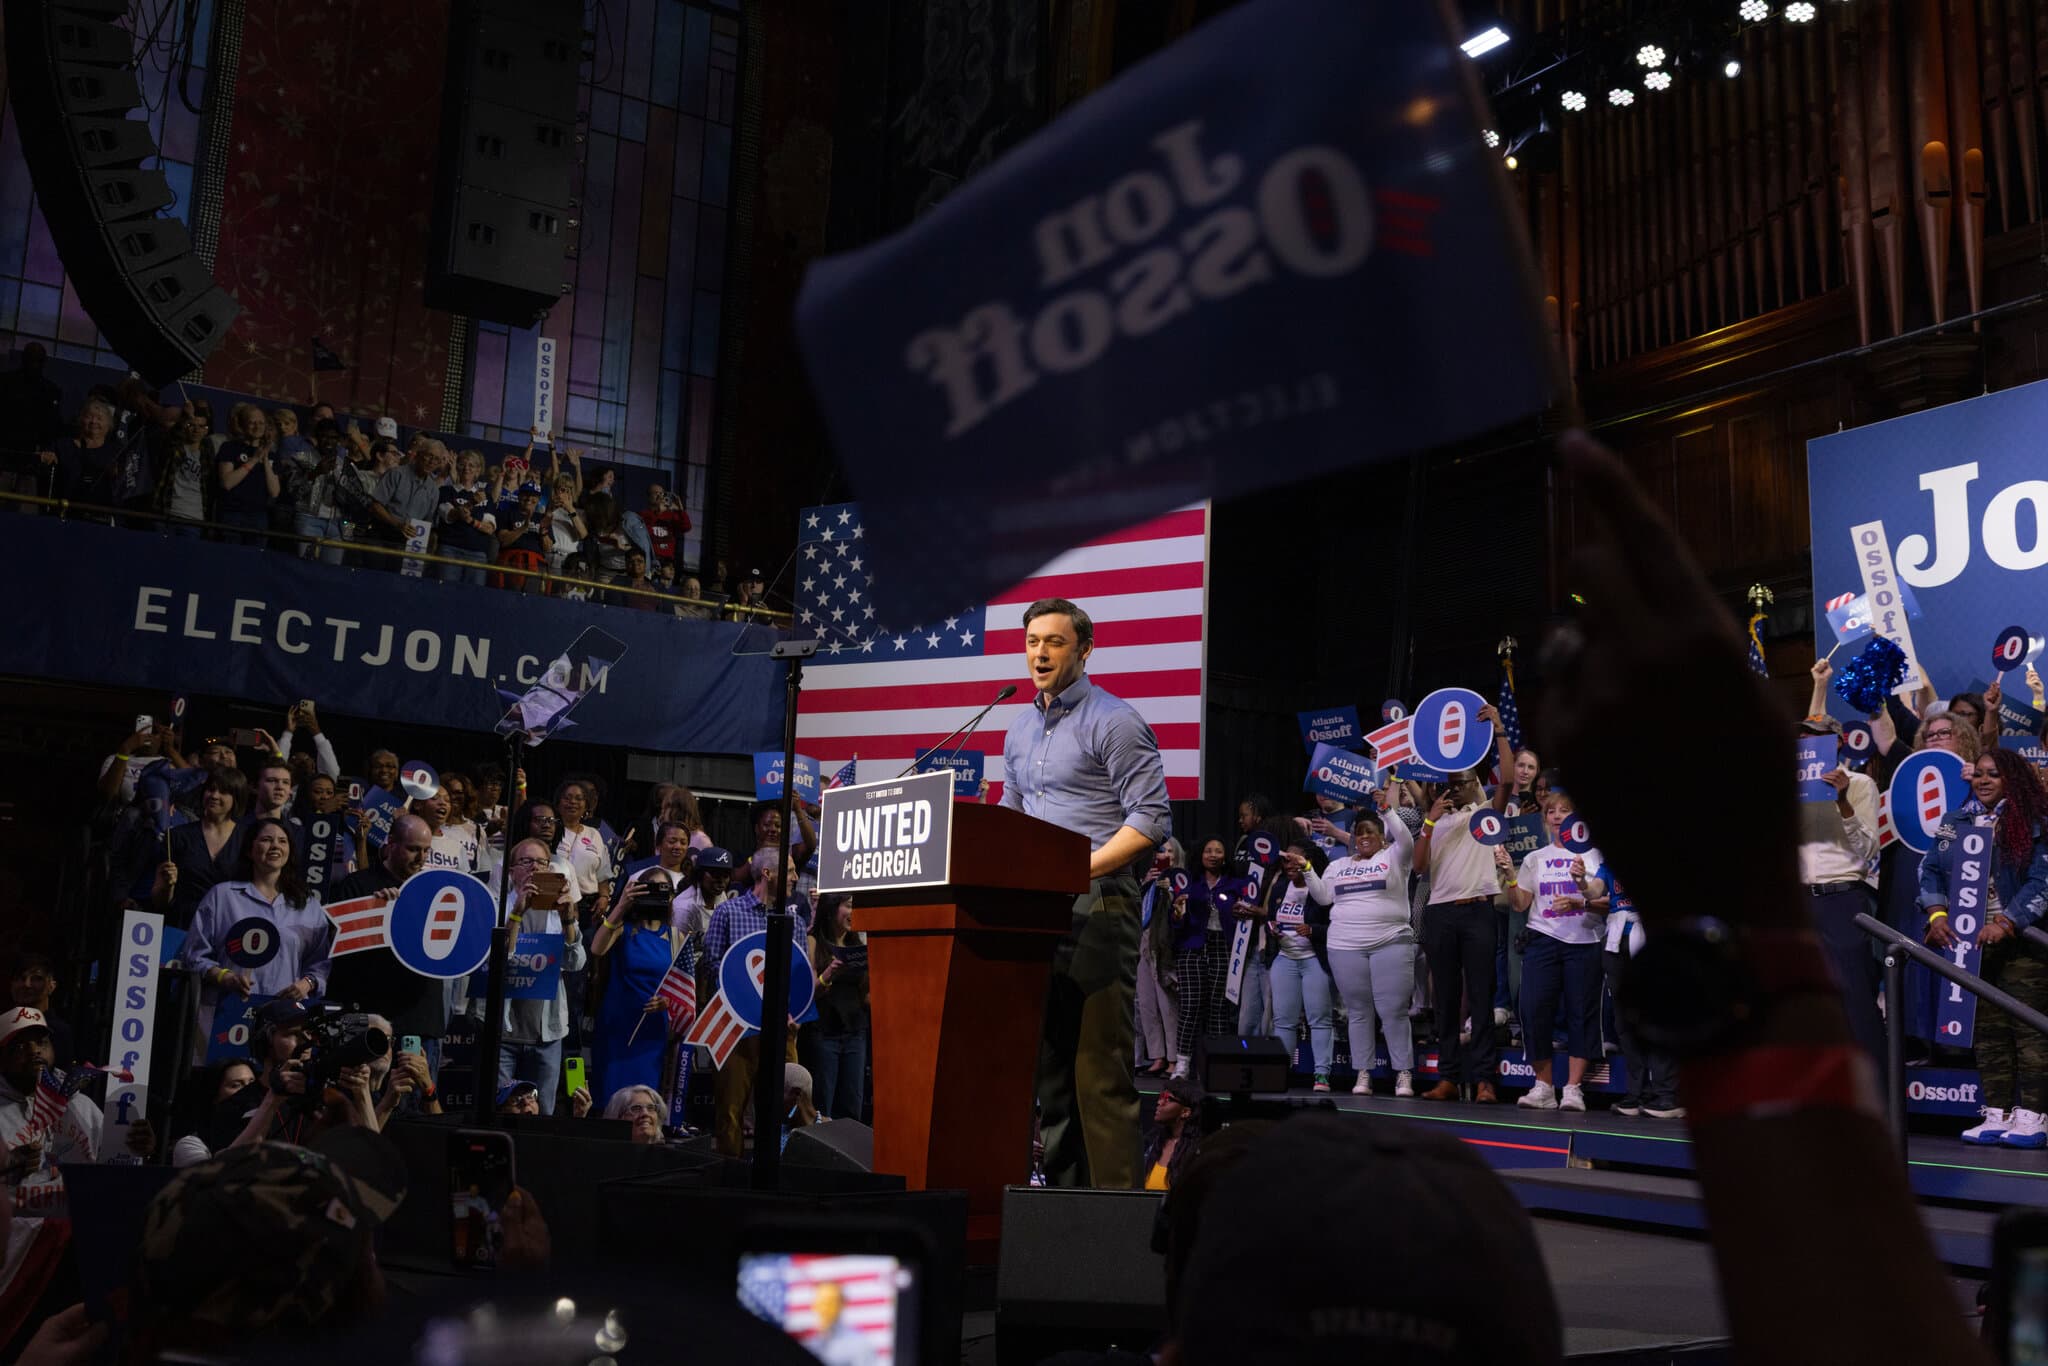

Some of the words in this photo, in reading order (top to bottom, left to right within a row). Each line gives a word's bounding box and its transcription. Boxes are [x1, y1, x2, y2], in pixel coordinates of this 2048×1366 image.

[1895, 461, 2048, 588] Jo
[1310, 724, 1353, 742] Ossoff
[1311, 715, 1344, 728] Atlanta
[1328, 756, 1371, 777] Atlanta
[1318, 766, 1376, 796] Ossoff
[836, 800, 932, 853] UNITED
[851, 848, 922, 880] GEORGIA
[1500, 1059, 1536, 1077] Osso
[675, 1050, 689, 1113] GOVERNOR
[1908, 1080, 1979, 1103] Ossoff
